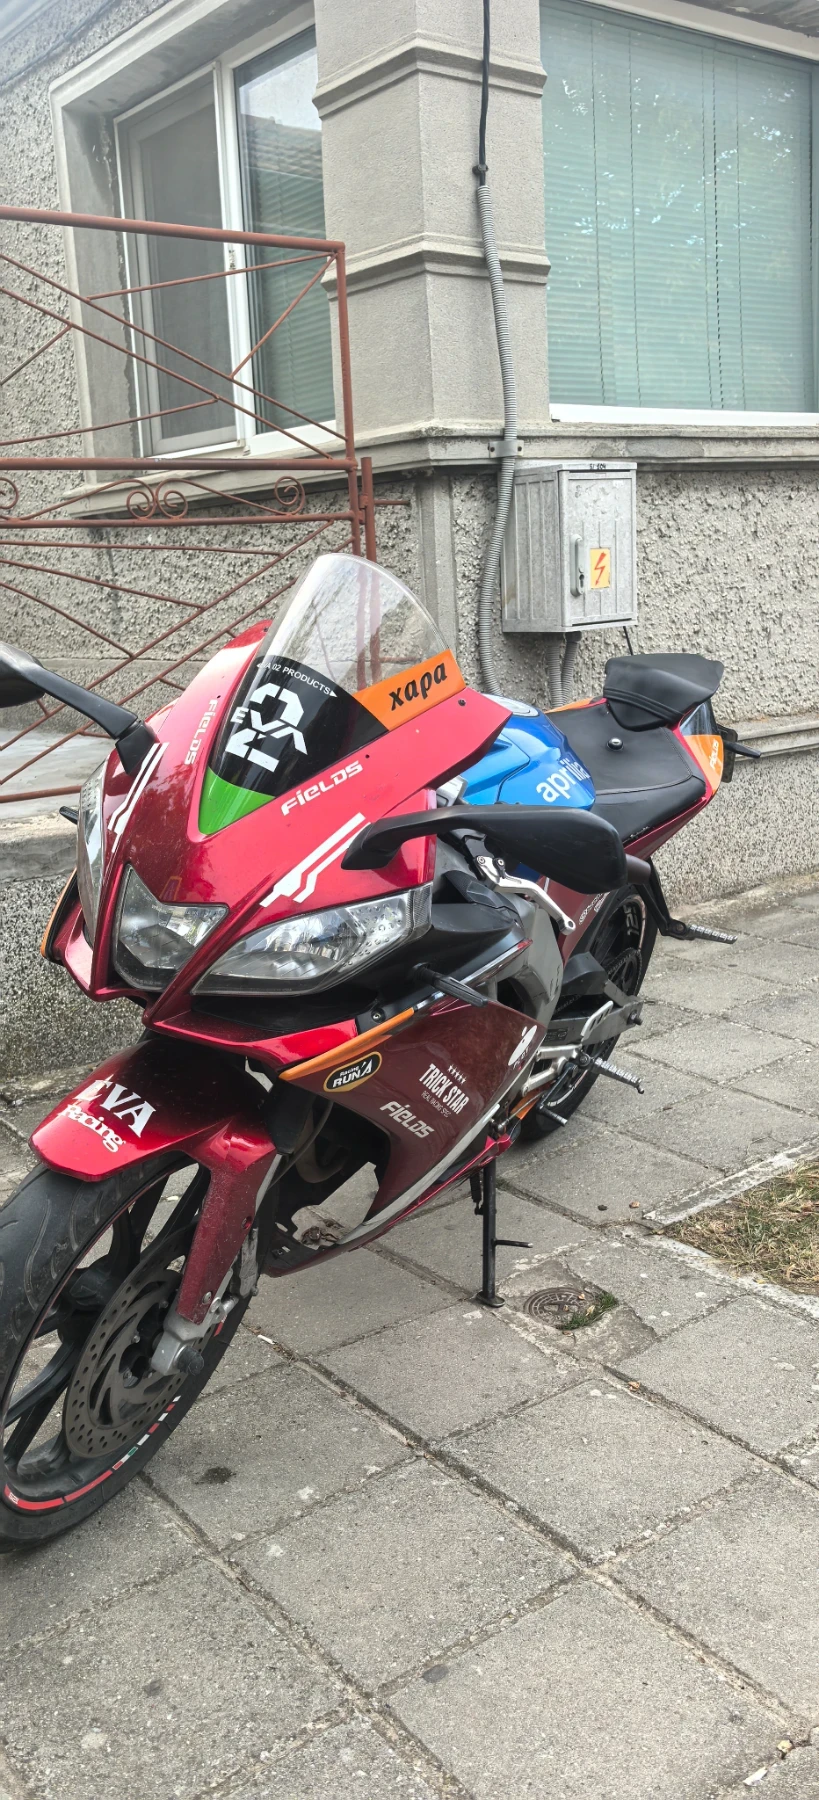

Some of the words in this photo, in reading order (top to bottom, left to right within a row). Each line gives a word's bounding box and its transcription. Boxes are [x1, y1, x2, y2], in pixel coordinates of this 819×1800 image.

[282, 666, 331, 694] PRODUCTS
[72, 1075, 156, 1138] EVA
[419, 1063, 453, 1098] TRICK
[442, 1085, 469, 1115] STAR
[58, 1104, 126, 1153] Racing
